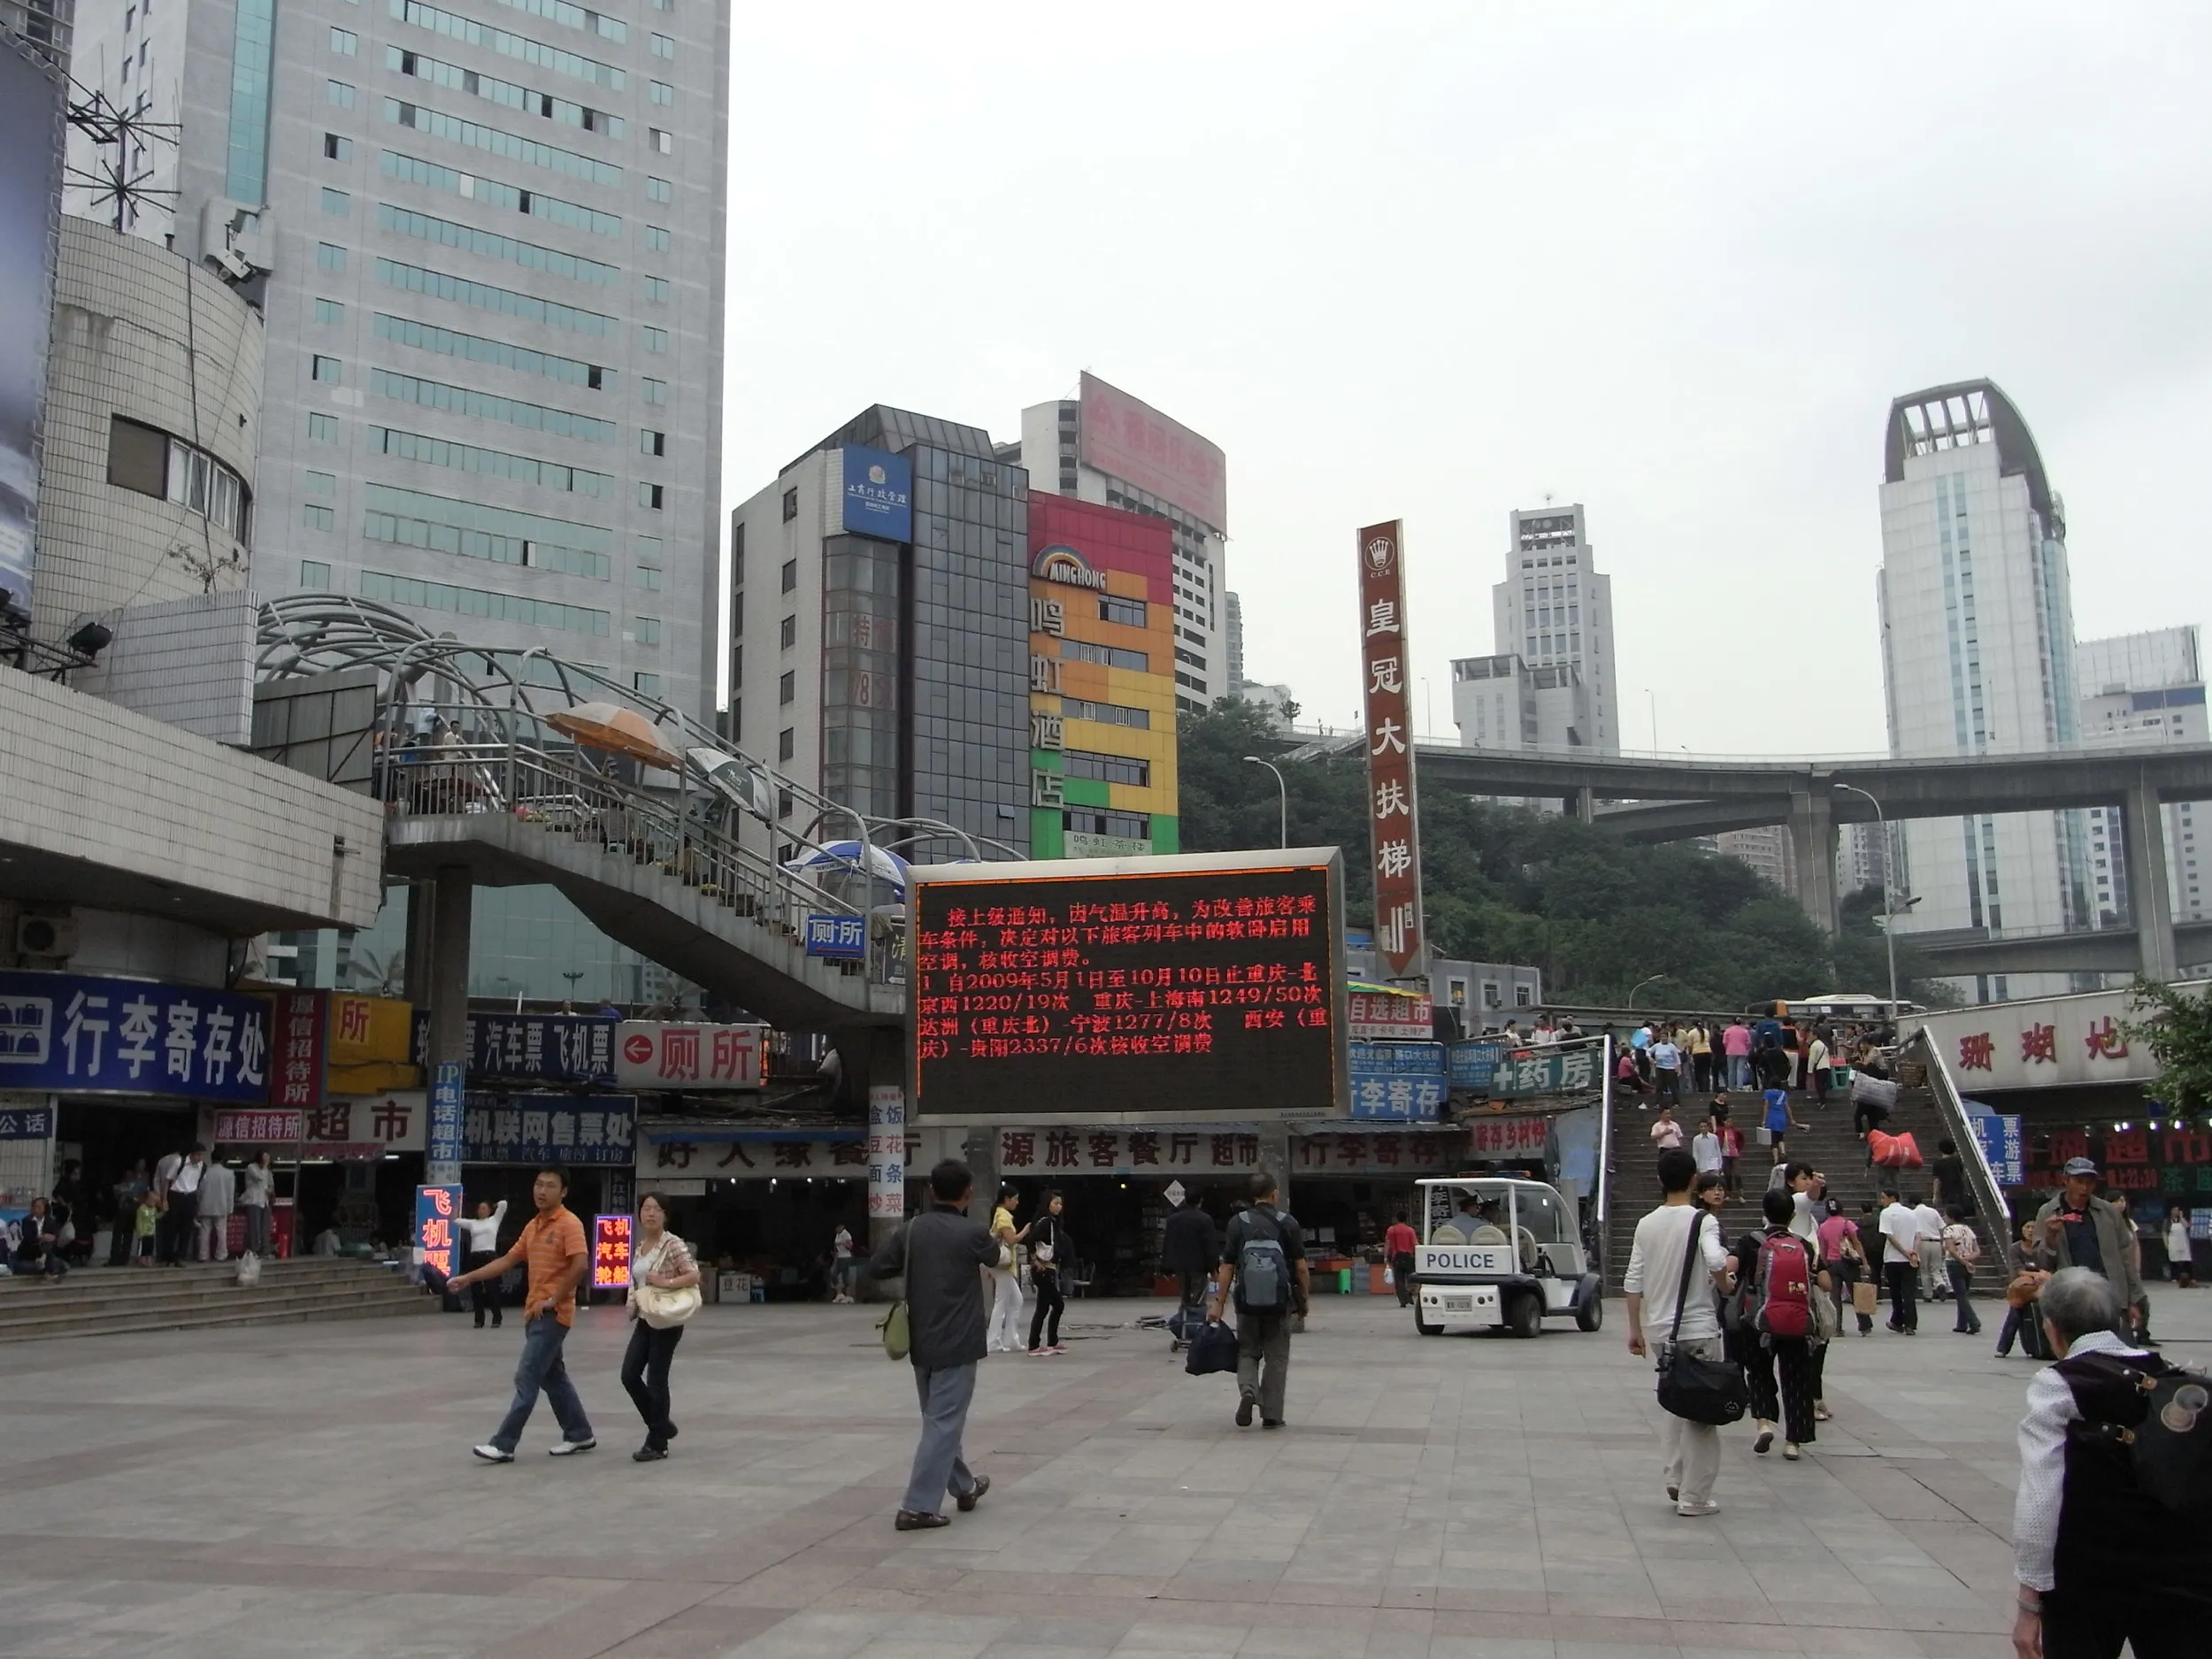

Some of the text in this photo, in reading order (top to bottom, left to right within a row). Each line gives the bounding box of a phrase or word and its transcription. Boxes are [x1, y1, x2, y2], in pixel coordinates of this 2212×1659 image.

[1049, 563, 1106, 588] MINGHONG
[1030, 597, 1064, 809] 鸣虹酒店
[1366, 597, 1412, 879] 皇冠大扶梯
[809, 917, 864, 946] 厕所
[339, 999, 370, 1043] 所
[1350, 995, 1431, 1022] 自选超市
[62, 989, 265, 1087] 行李寄存处
[283, 995, 315, 1104] 源信招待所
[486, 1020, 545, 1071] 汽车票
[554, 1022, 611, 1072] 飞机票
[1959, 1016, 2129, 1071] 珊瑚地
[658, 1029, 754, 1081] 厕所
[1517, 1052, 1593, 1090] 药房
[0, 1112, 46, 1133] 公话
[218, 1115, 300, 1140] 源信招待所
[306, 1100, 412, 1141] 超市
[432, 1064, 459, 1160] IP电话超市
[870, 1105, 902, 1125] 盒饭
[870, 1134, 902, 1154] 豆花
[869, 1163, 902, 1184] 面条
[597, 1218, 631, 1237] 飞机
[596, 1240, 630, 1261] 汽车
[1427, 1253, 1494, 1269] POLICE
